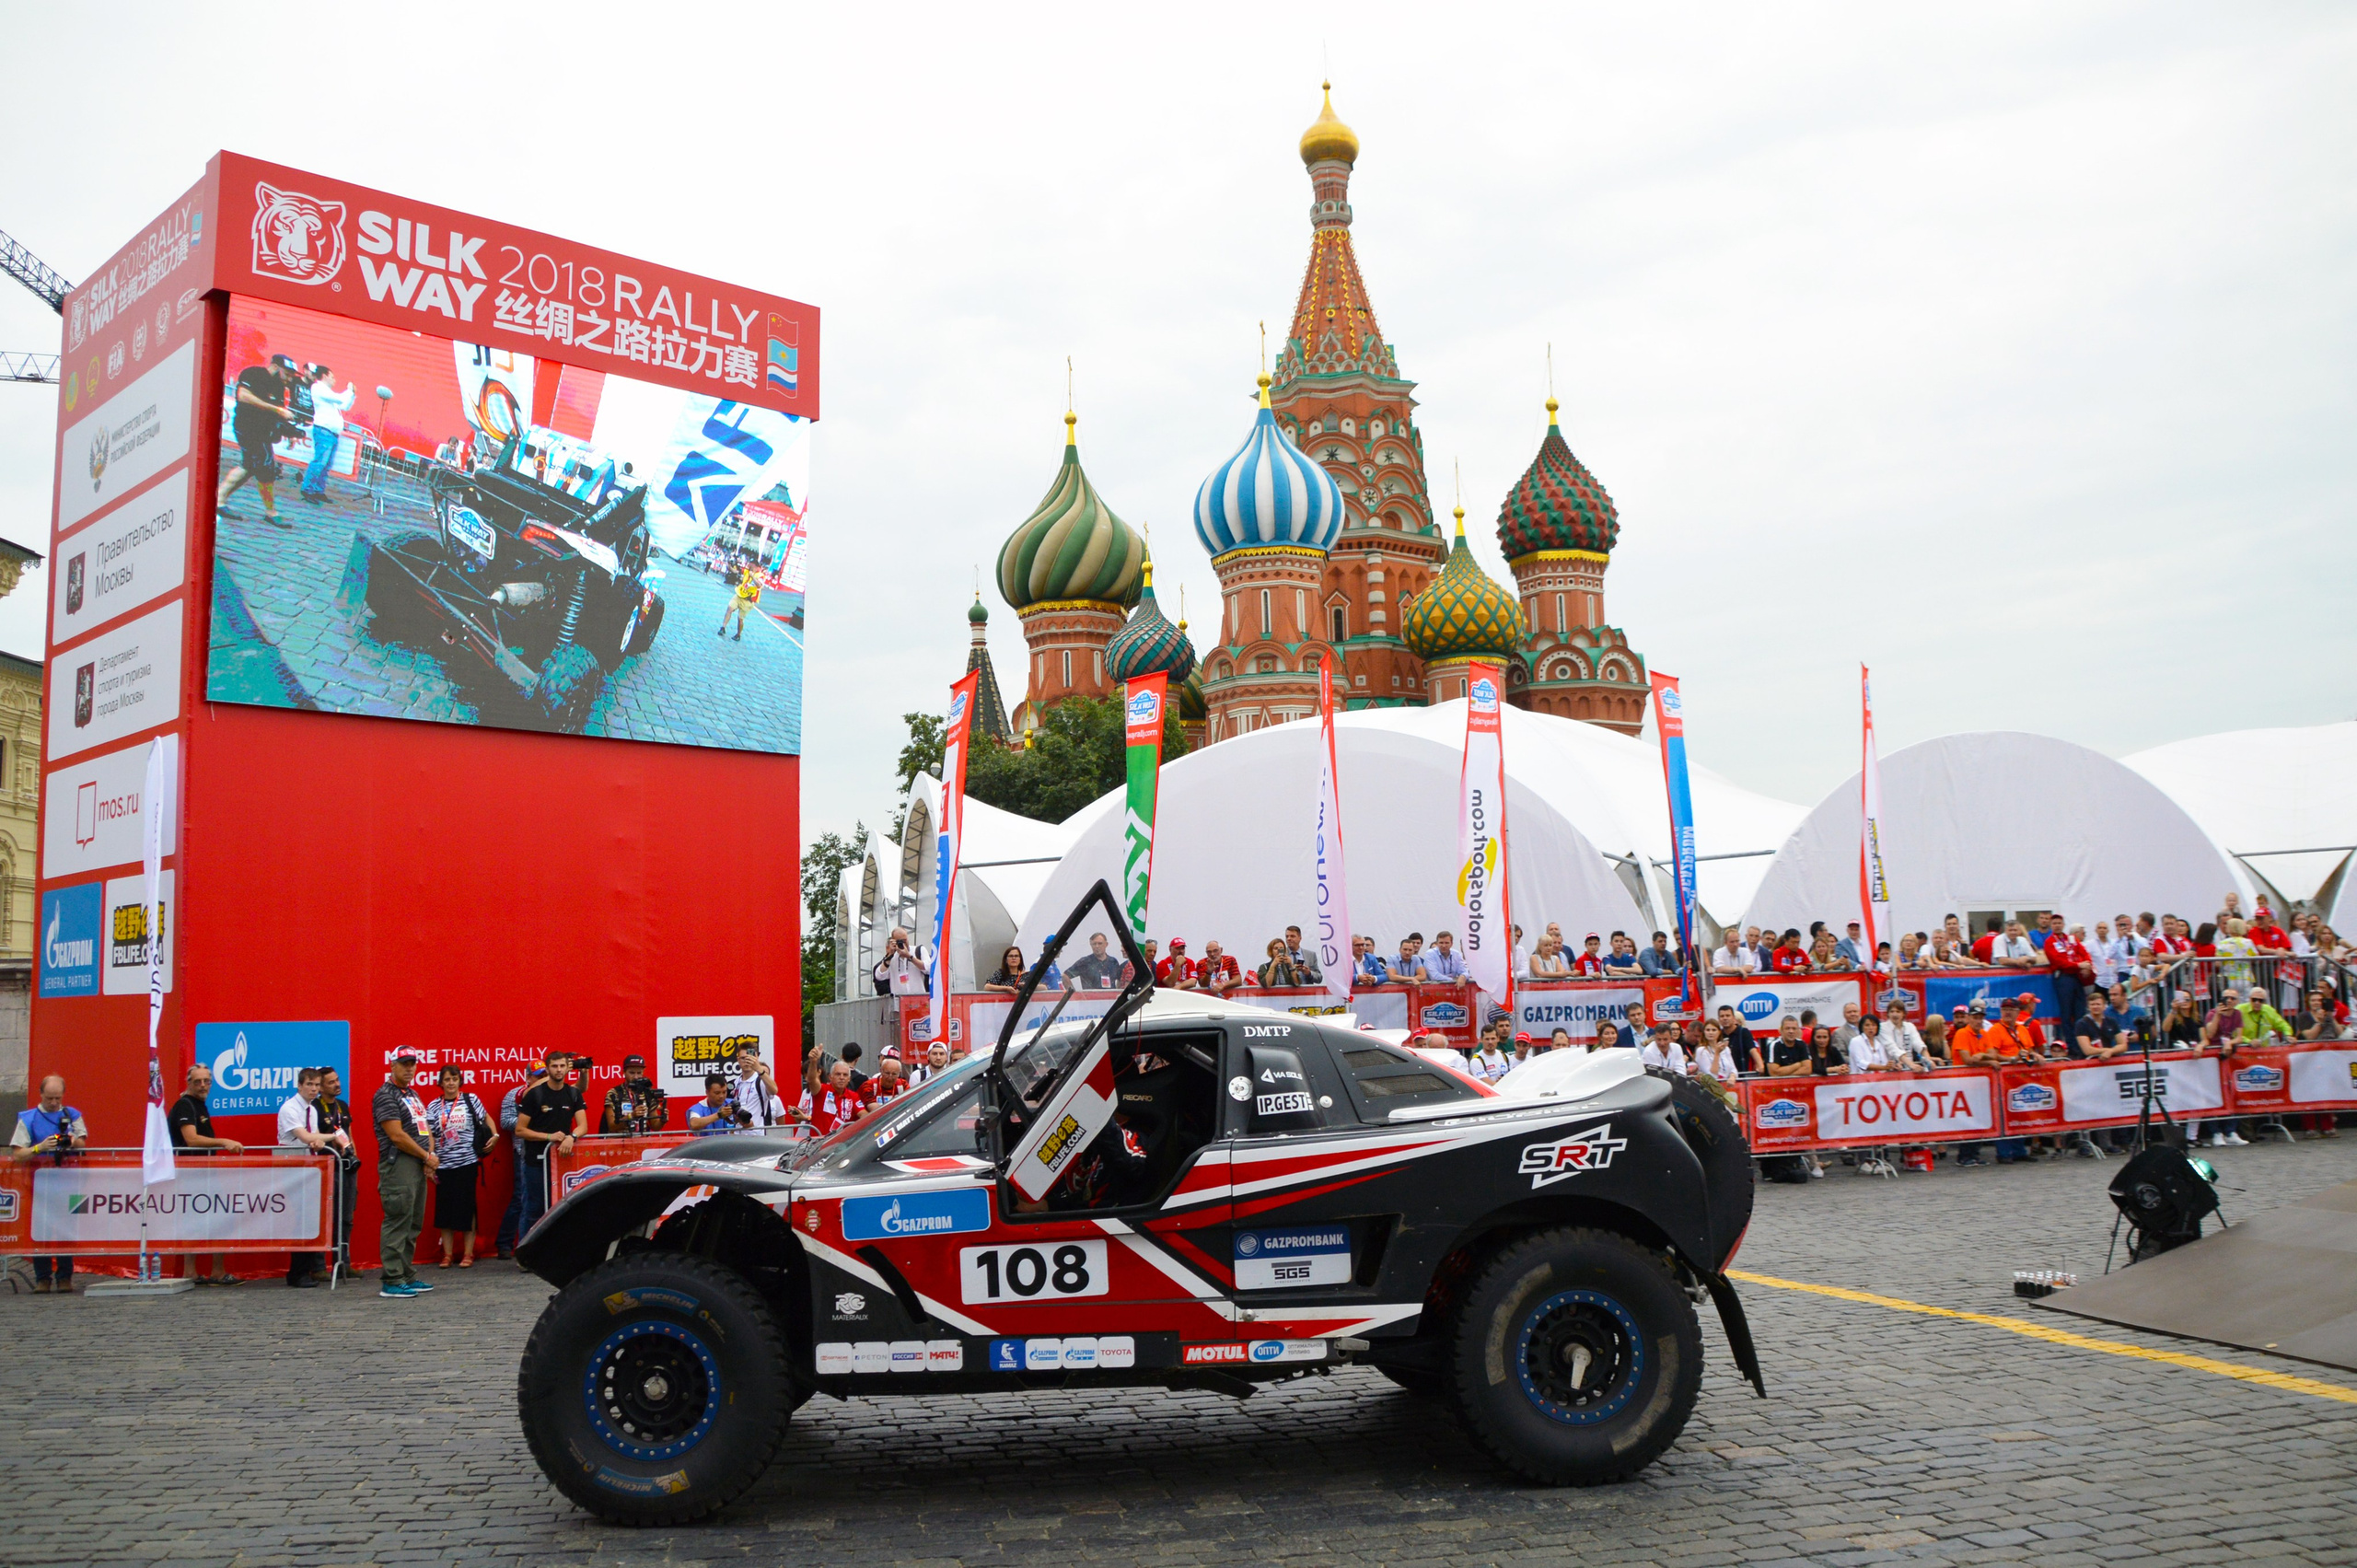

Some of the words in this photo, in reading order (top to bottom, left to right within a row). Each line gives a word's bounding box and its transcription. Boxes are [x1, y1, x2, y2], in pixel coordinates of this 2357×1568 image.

[120, 241, 147, 285] 2018
[147, 202, 192, 261] RALLY
[357, 210, 487, 281] SILK
[118, 232, 191, 314] 丝绸之路拉力赛
[89, 264, 119, 310] SILK
[357, 254, 486, 322] WAY
[499, 245, 606, 308] 2018
[614, 273, 760, 343] RALLY
[89, 292, 118, 335] WAY
[493, 288, 759, 390] 丝绸之路拉力赛
[97, 508, 174, 569] Правительство
[95, 563, 134, 598] Москвы
[99, 646, 140, 676] Департамент
[98, 677, 119, 695] спорта
[120, 676, 125, 686] и
[125, 664, 152, 689] туризма
[97, 699, 119, 718] города
[119, 690, 145, 708] Москвы
[99, 793, 138, 821] mos.ru
[58, 939, 93, 968] GAZPROM
[44, 974, 67, 990] GENERAL
[68, 973, 92, 988] PARTNER
[1524, 1005, 1628, 1023] GAZPROMBAN
[1743, 1000, 1773, 1013] ОПТИ
[1243, 1026, 1291, 1038] DMTP
[442, 1048, 489, 1063] THAN
[493, 1046, 548, 1062] RALLY
[481, 1067, 528, 1085] THAN
[1122, 1094, 1153, 1102] RECARO
[2119, 1079, 2167, 1098] SGS
[213, 1097, 271, 1109] GENERAL
[1259, 1094, 1306, 1113] IP.GEST
[1762, 1109, 1783, 1117] SILK
[1835, 1090, 1973, 1125] TOYOTA
[896, 1113, 915, 1132] MATT
[1048, 1126, 1086, 1172] FBLIFE.COM
[1518, 1138, 1628, 1174] SRT
[902, 1215, 952, 1232] GAZPROM
[1264, 1233, 1344, 1249] GAZPROMBANK
[976, 1244, 1089, 1298] 108
[1274, 1266, 1310, 1280] SGS
[641, 1292, 695, 1309] MICHELIN
[835, 1293, 865, 1314] RG
[929, 1351, 958, 1360] МАТЧ!
[1186, 1346, 1246, 1362] MOTUL
[1258, 1345, 1280, 1356] ОПТИ
[598, 1473, 653, 1493] MICHELIN
